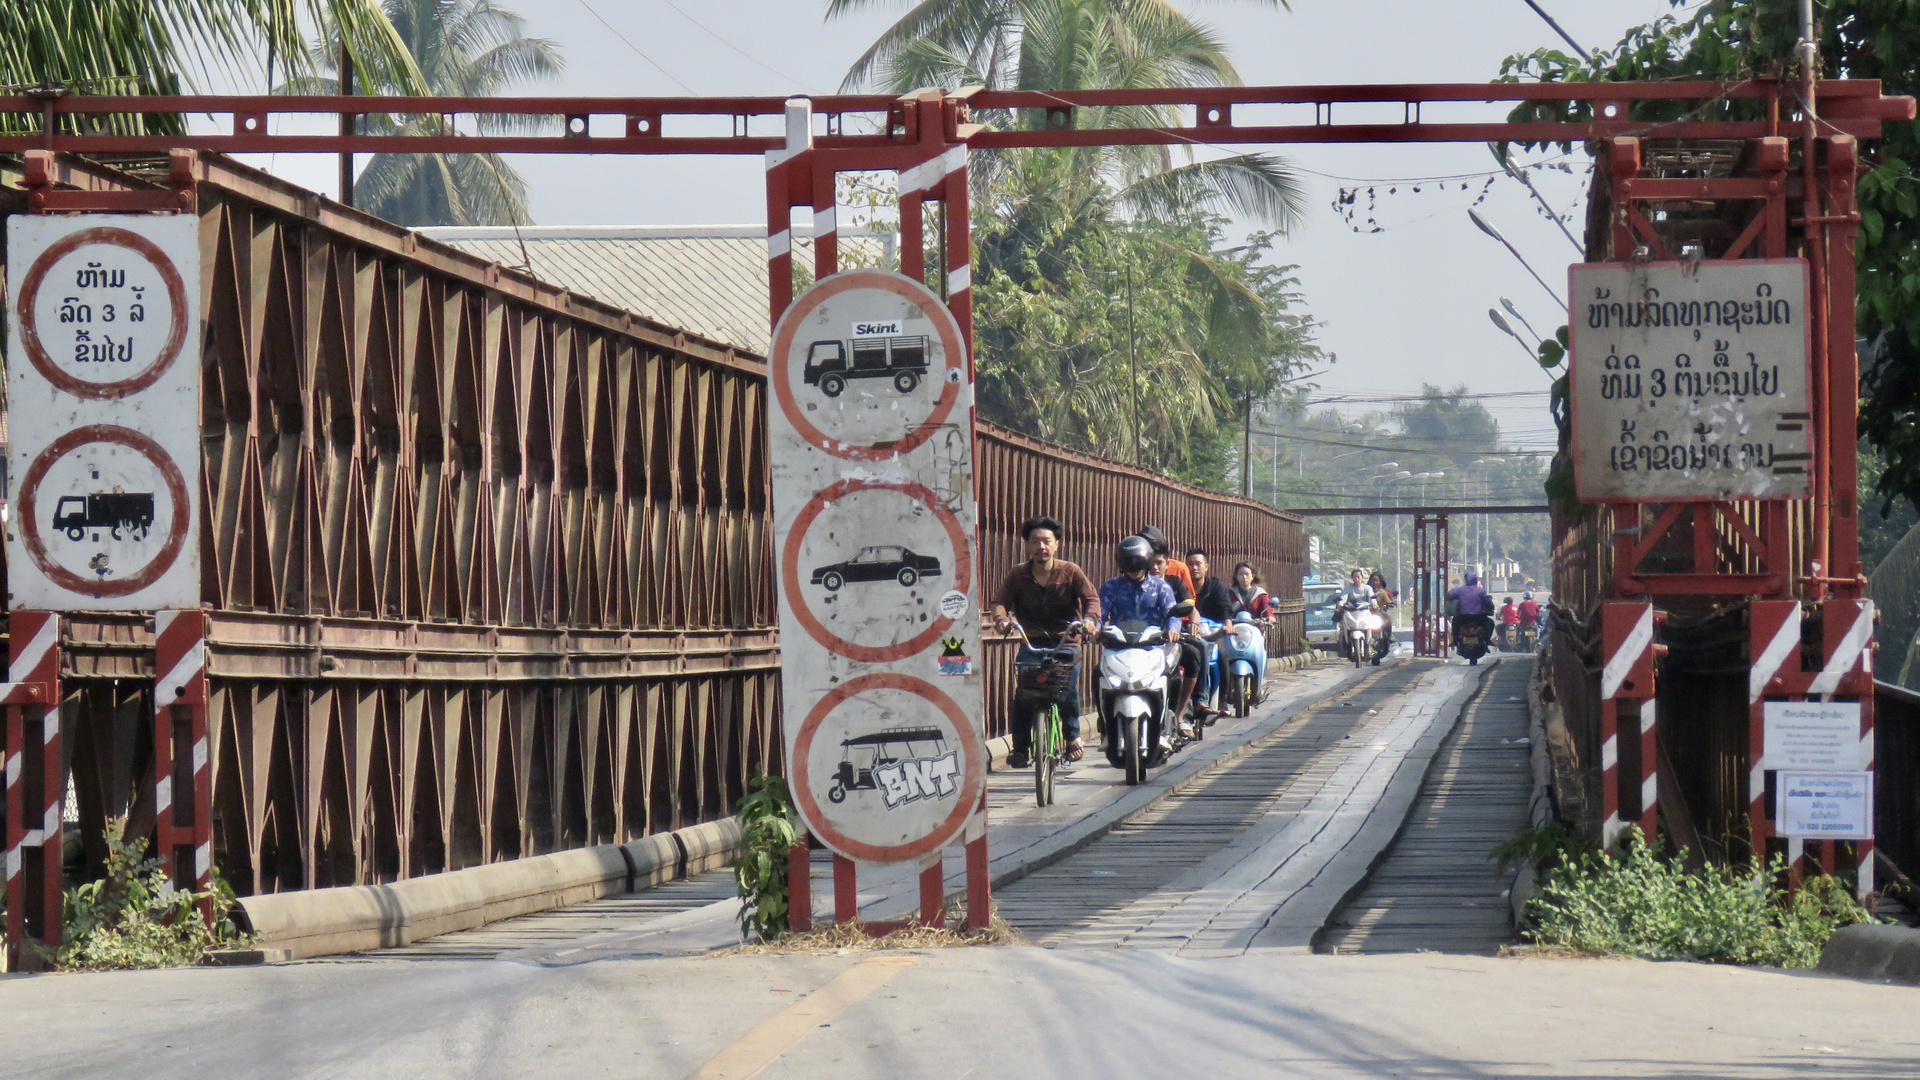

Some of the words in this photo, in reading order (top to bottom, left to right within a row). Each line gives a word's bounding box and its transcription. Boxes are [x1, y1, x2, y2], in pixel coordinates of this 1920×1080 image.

[76, 262, 125, 288] ຫ້າມ
[60, 296, 92, 323] ລົດ
[102, 304, 116, 323] 3
[855, 323, 899, 335] Skint.
[1651, 368, 1667, 398] 3
[875, 752, 958, 809] BNT
